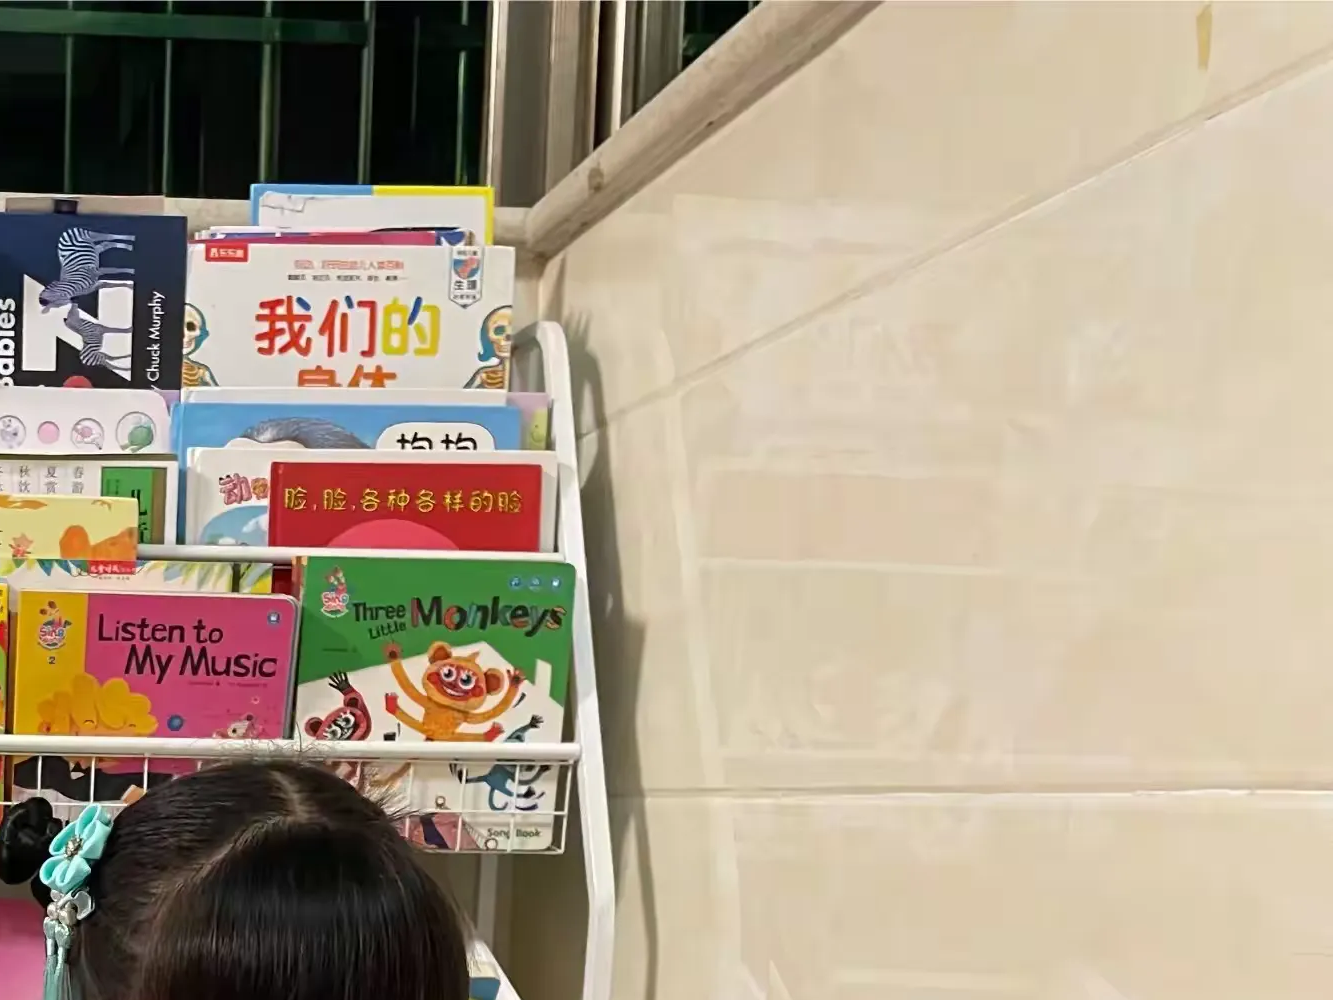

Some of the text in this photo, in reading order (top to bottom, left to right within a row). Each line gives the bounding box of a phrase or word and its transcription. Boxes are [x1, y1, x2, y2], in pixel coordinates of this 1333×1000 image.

[147, 291, 165, 381] Chuck Murphy
[255, 295, 441, 357] 我们的
[98, 613, 223, 644] Listen to
[353, 596, 567, 637] Three Monkeys
[368, 620, 406, 640] Little
[48, 656, 56, 665] 2
[124, 644, 277, 684] My Music
